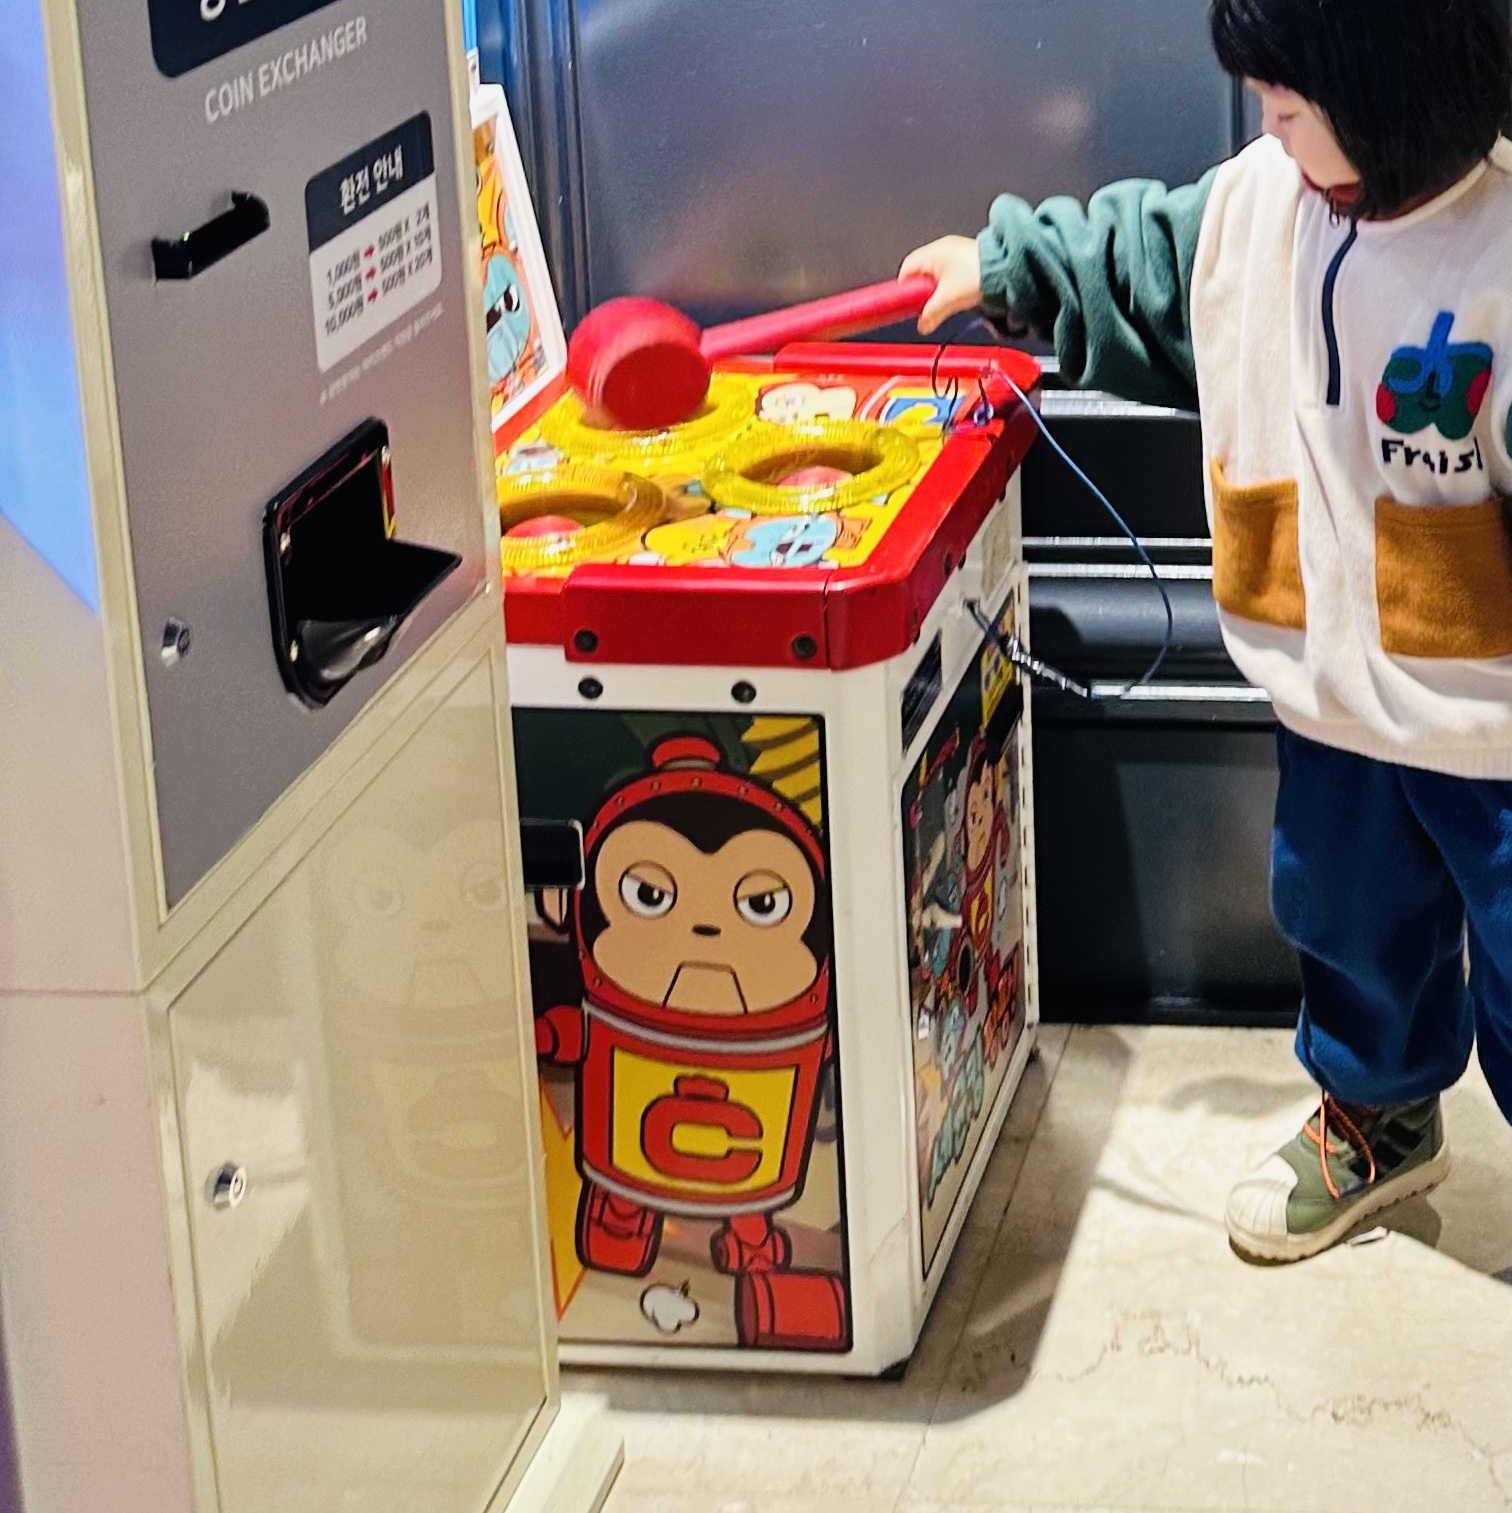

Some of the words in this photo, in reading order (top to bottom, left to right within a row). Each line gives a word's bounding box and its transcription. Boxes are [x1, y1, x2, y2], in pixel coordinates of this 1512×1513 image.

[204, 78, 256, 124] COIN
[258, 16, 368, 98] EXCHANGER
[340, 163, 371, 216] 환전
[373, 145, 404, 193] 안내
